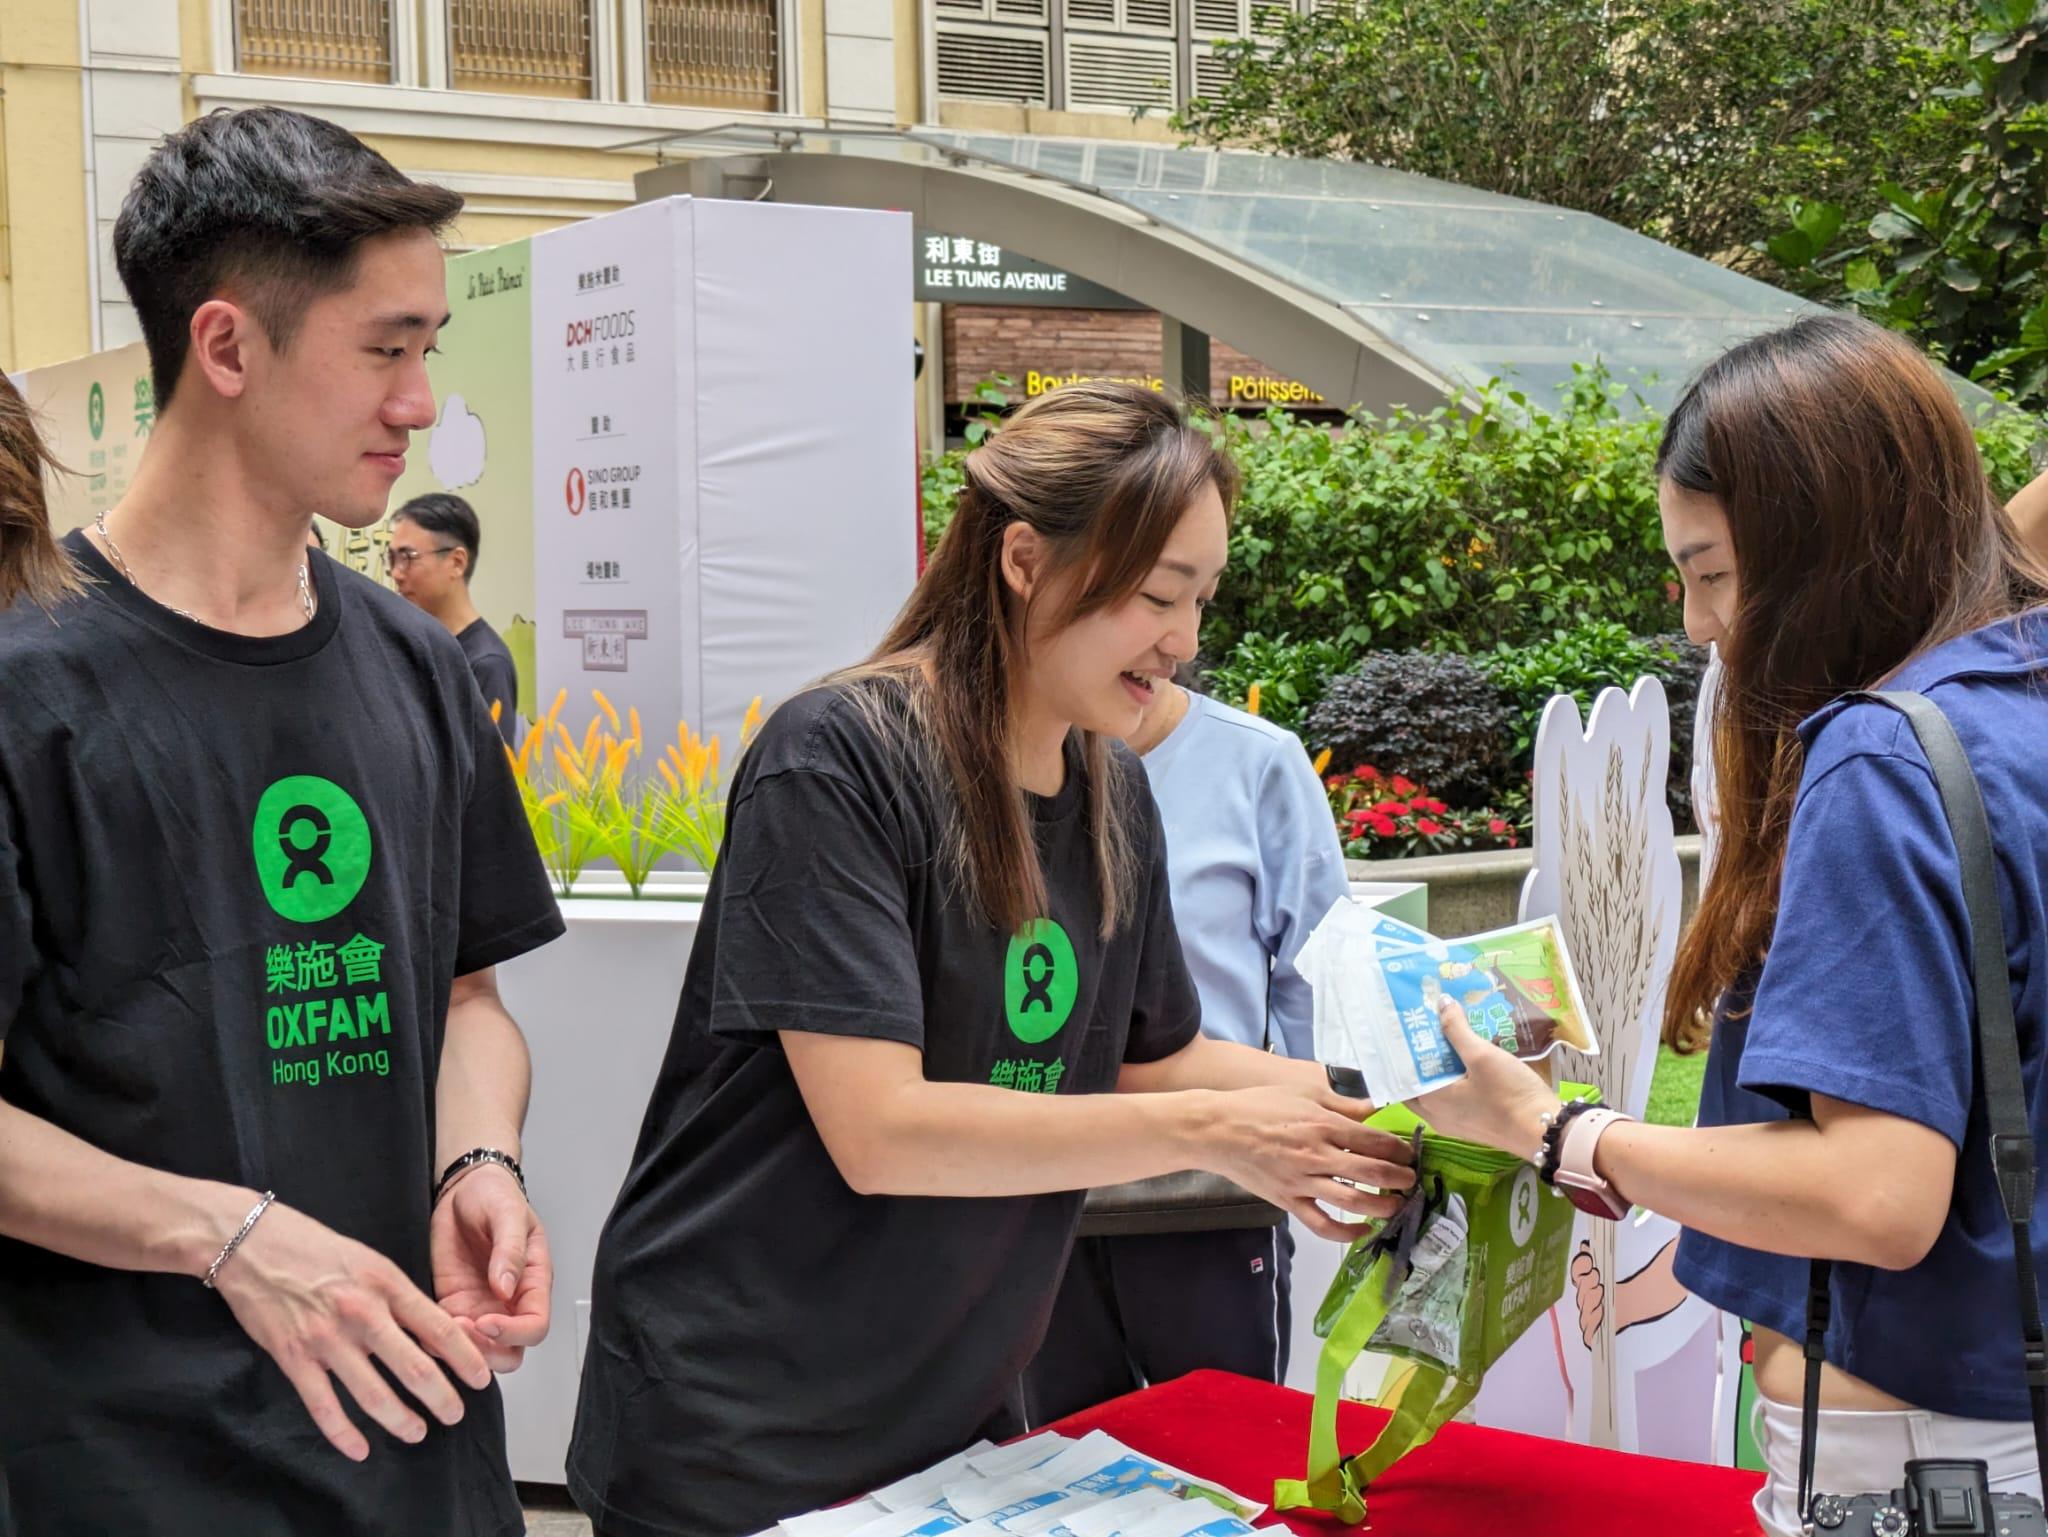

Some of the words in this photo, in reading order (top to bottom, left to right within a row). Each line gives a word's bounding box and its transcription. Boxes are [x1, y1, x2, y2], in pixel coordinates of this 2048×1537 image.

[925, 236, 1001, 267] 利東街
[925, 269, 952, 287] LEE
[955, 270, 1000, 289] TUNG
[1003, 272, 1067, 291] AVENUE
[588, 468, 608, 485] SINO
[610, 465, 641, 483] GROUP
[266, 933, 386, 995] 樂施會
[266, 992, 392, 1050] OXFAM
[273, 1059, 321, 1087] Hong
[327, 1050, 390, 1078] Kong
